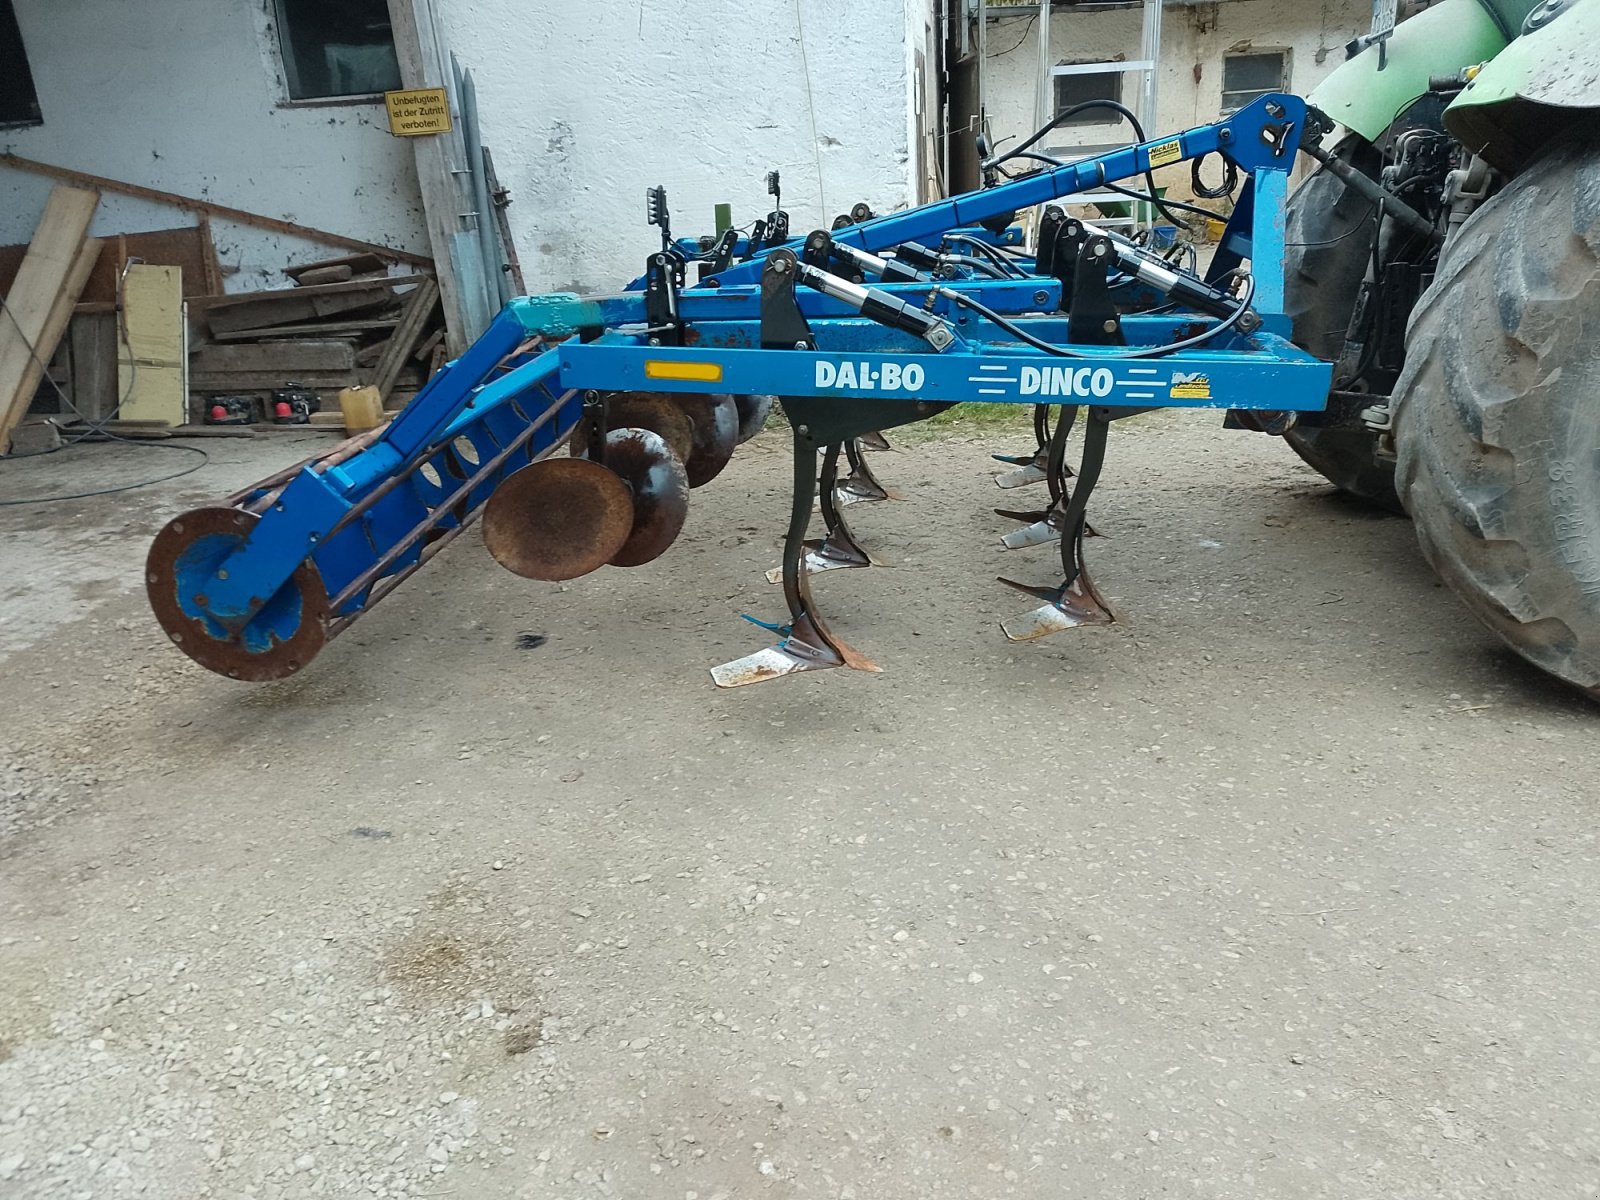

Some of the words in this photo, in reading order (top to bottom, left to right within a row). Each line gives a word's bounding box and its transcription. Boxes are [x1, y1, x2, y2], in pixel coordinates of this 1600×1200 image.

[392, 95, 440, 106] Unbefugten
[392, 109, 403, 118] ist
[404, 108, 417, 117] der
[419, 106, 444, 116] Zutritt
[401, 118, 440, 129] verboten!
[1019, 366, 1114, 397] DINCO
